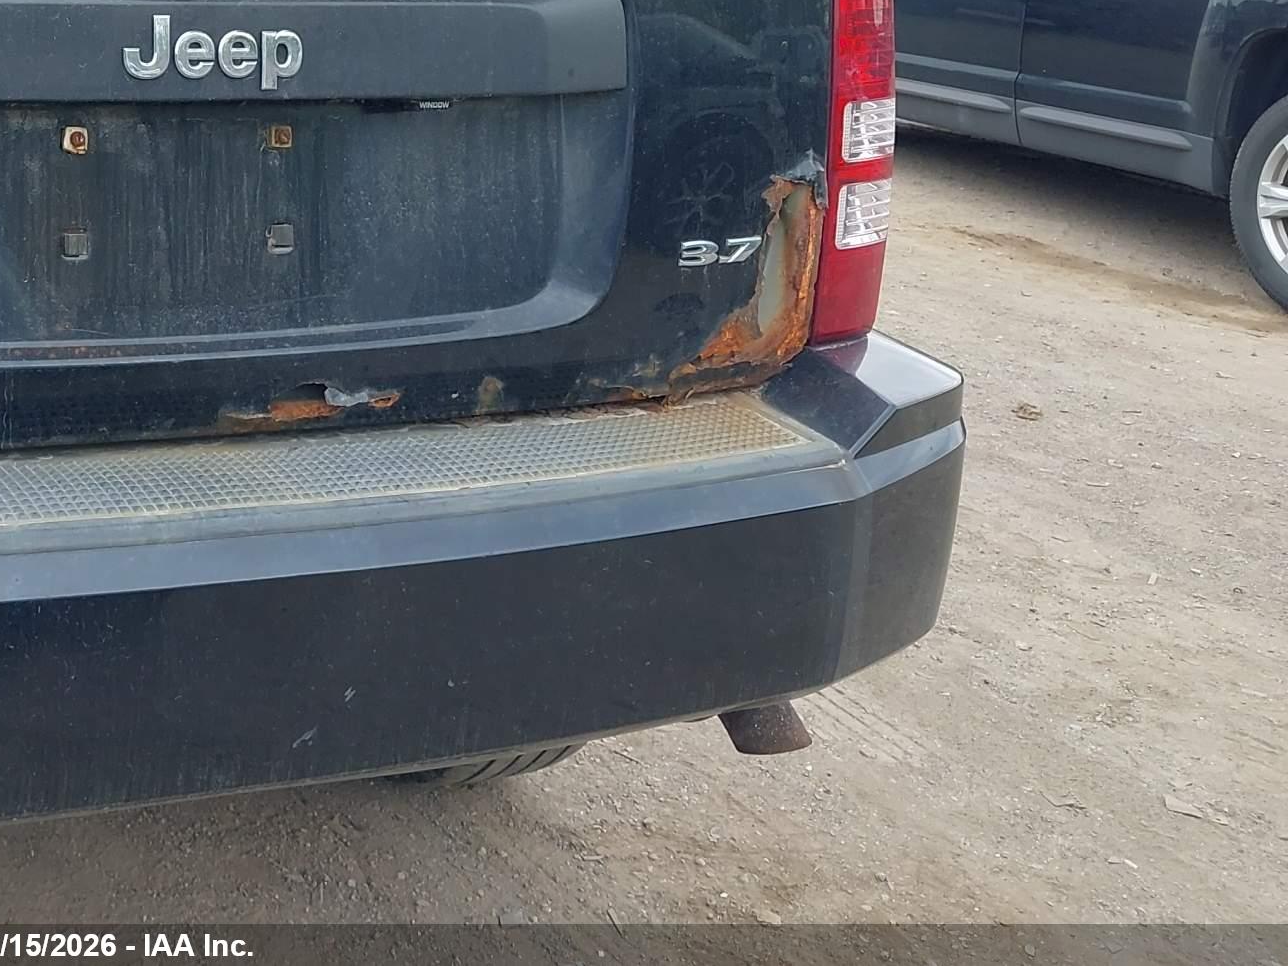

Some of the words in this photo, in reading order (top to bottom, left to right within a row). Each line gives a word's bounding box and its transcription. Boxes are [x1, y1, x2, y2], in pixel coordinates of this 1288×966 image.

[122, 14, 304, 90] Jeep
[419, 100, 450, 109] WINDOW
[678, 235, 763, 266] 3.7
